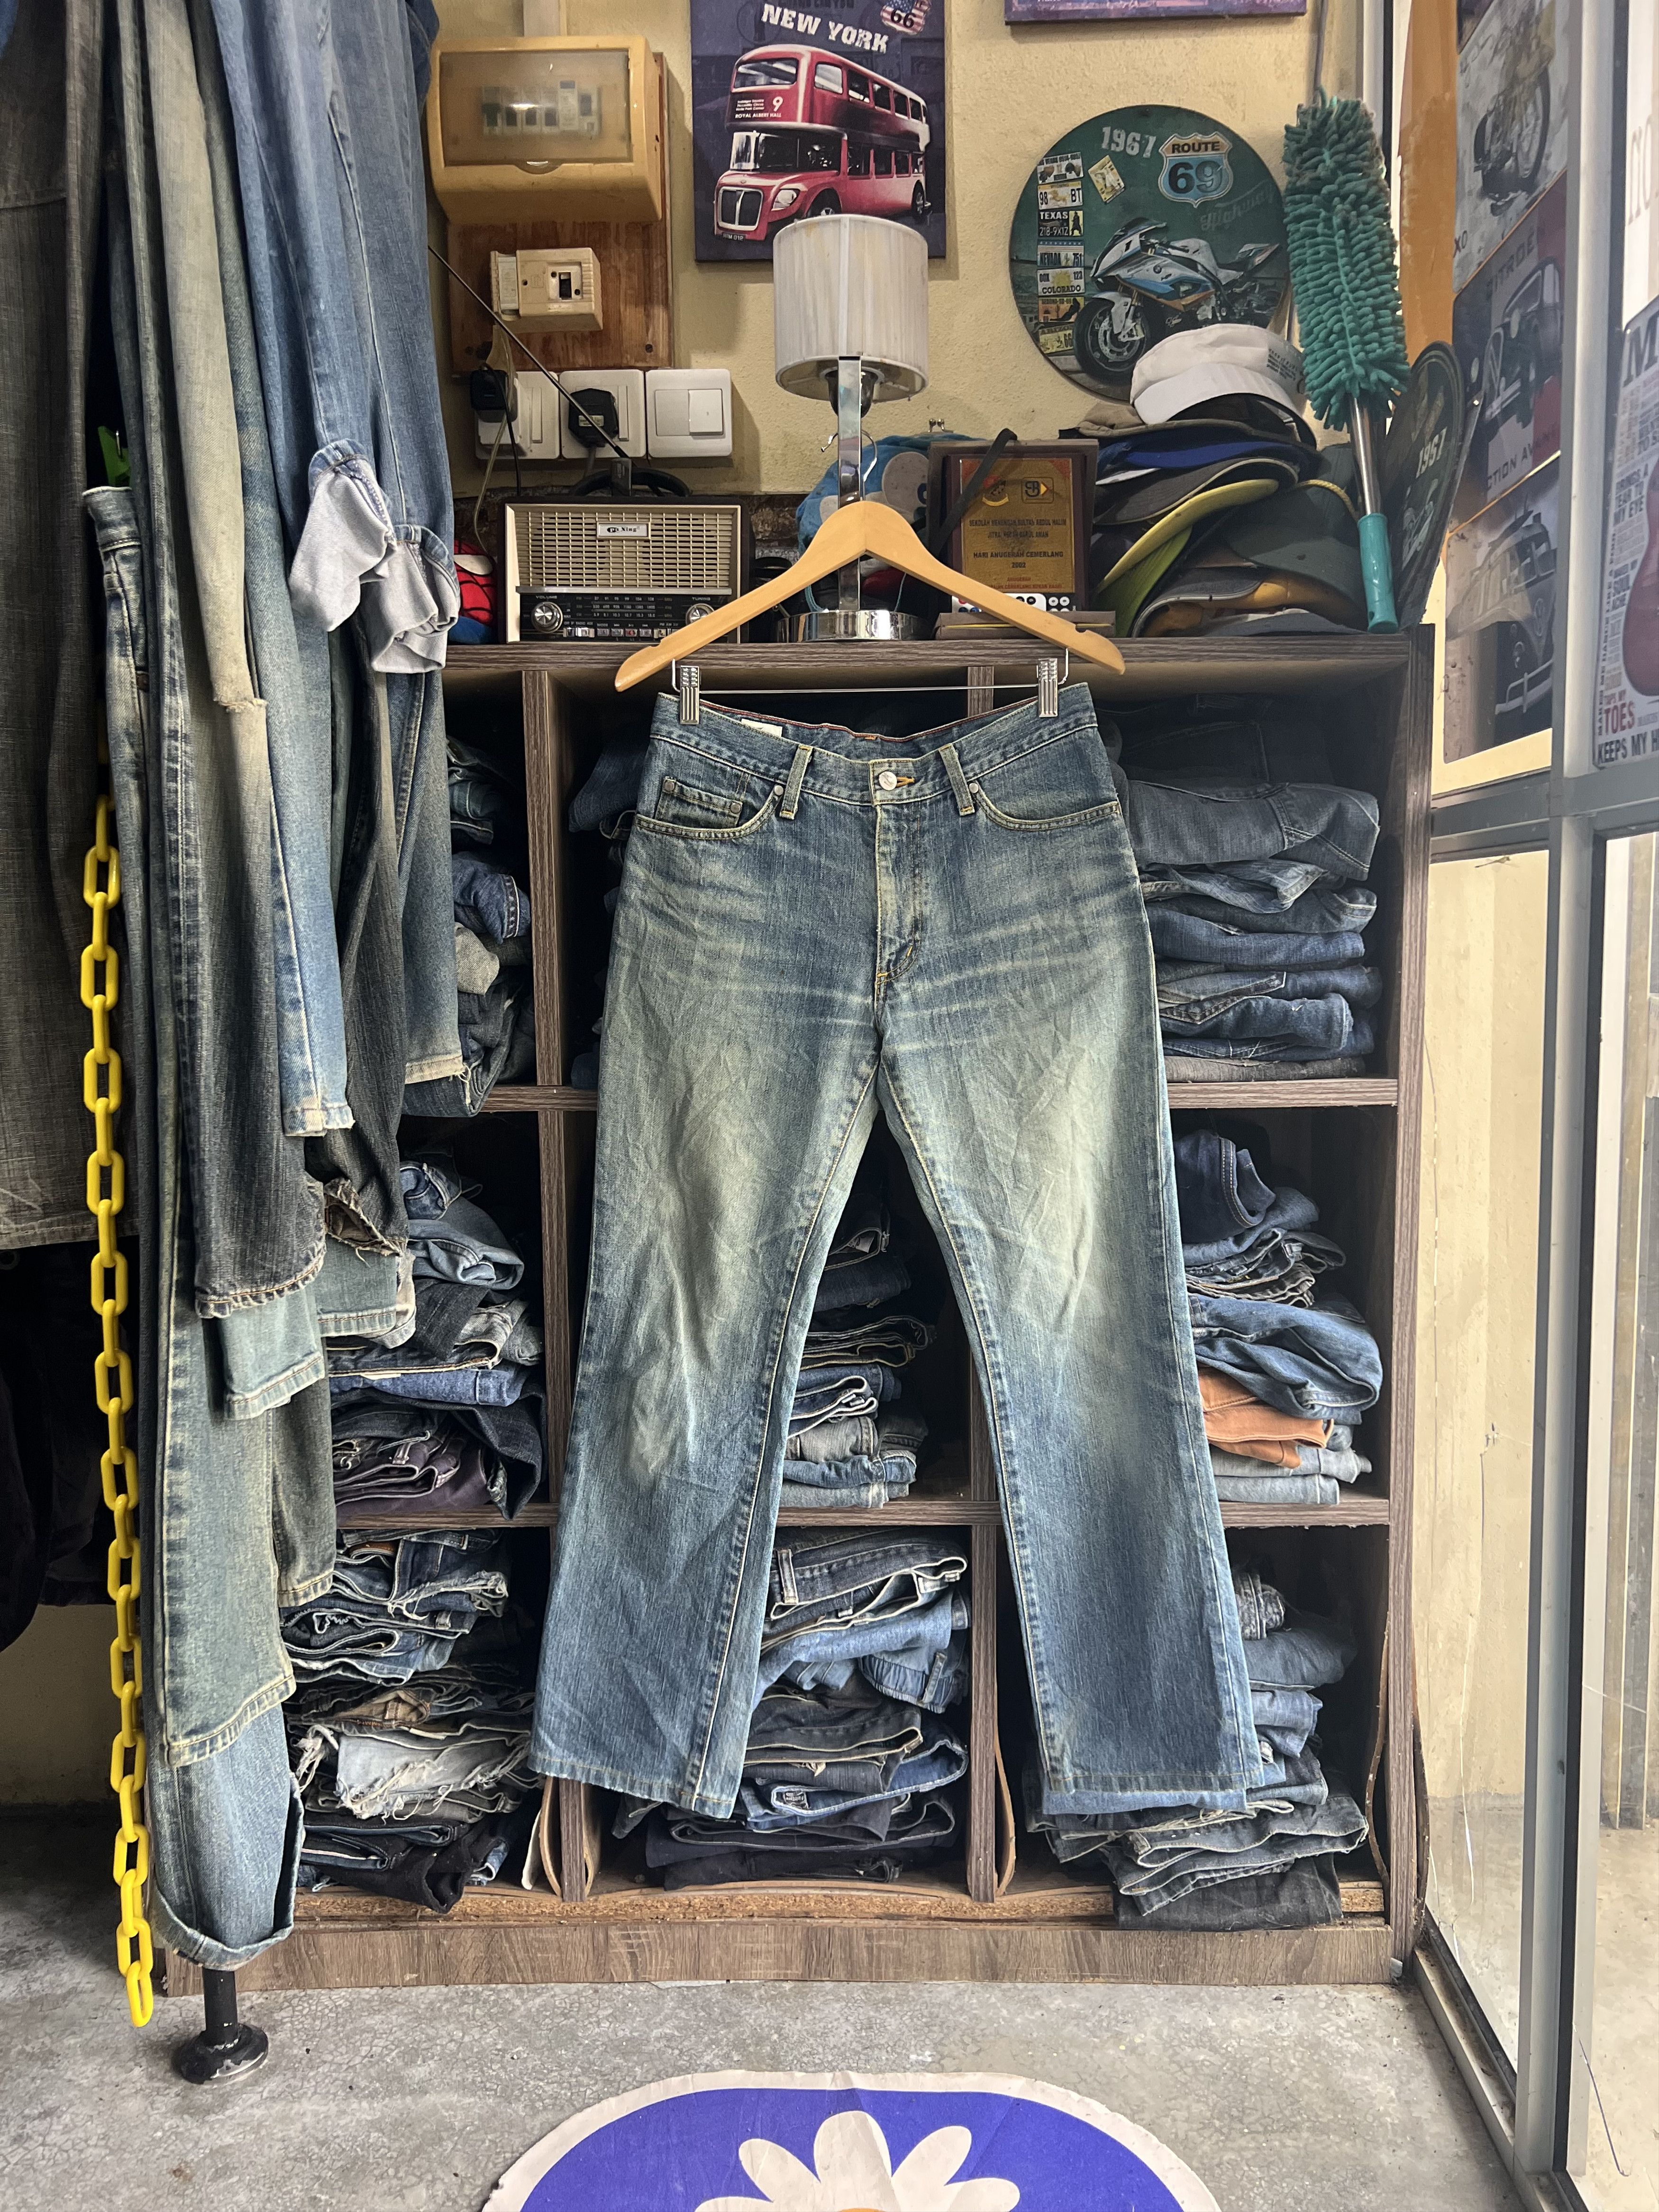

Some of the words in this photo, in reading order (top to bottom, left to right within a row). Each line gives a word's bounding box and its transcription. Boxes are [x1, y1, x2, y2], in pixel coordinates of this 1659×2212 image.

[761, 3, 821, 36] NEW
[829, 21, 889, 54] YORK
[890, 9, 917, 29] 66
[773, 96, 784, 112] 9
[1101, 126, 1157, 159] 1967
[1171, 141, 1221, 154] ROUTE
[1168, 160, 1223, 194] 69
[1039, 191, 1048, 206] 98
[1070, 188, 1082, 203] BT
[1039, 211, 1068, 220] TEXAS
[1042, 284, 1081, 294] COLORADO
[1604, 701, 1635, 736] TOES
[1598, 737, 1628, 765] KEEPS
[1631, 731, 1647, 756] MY
